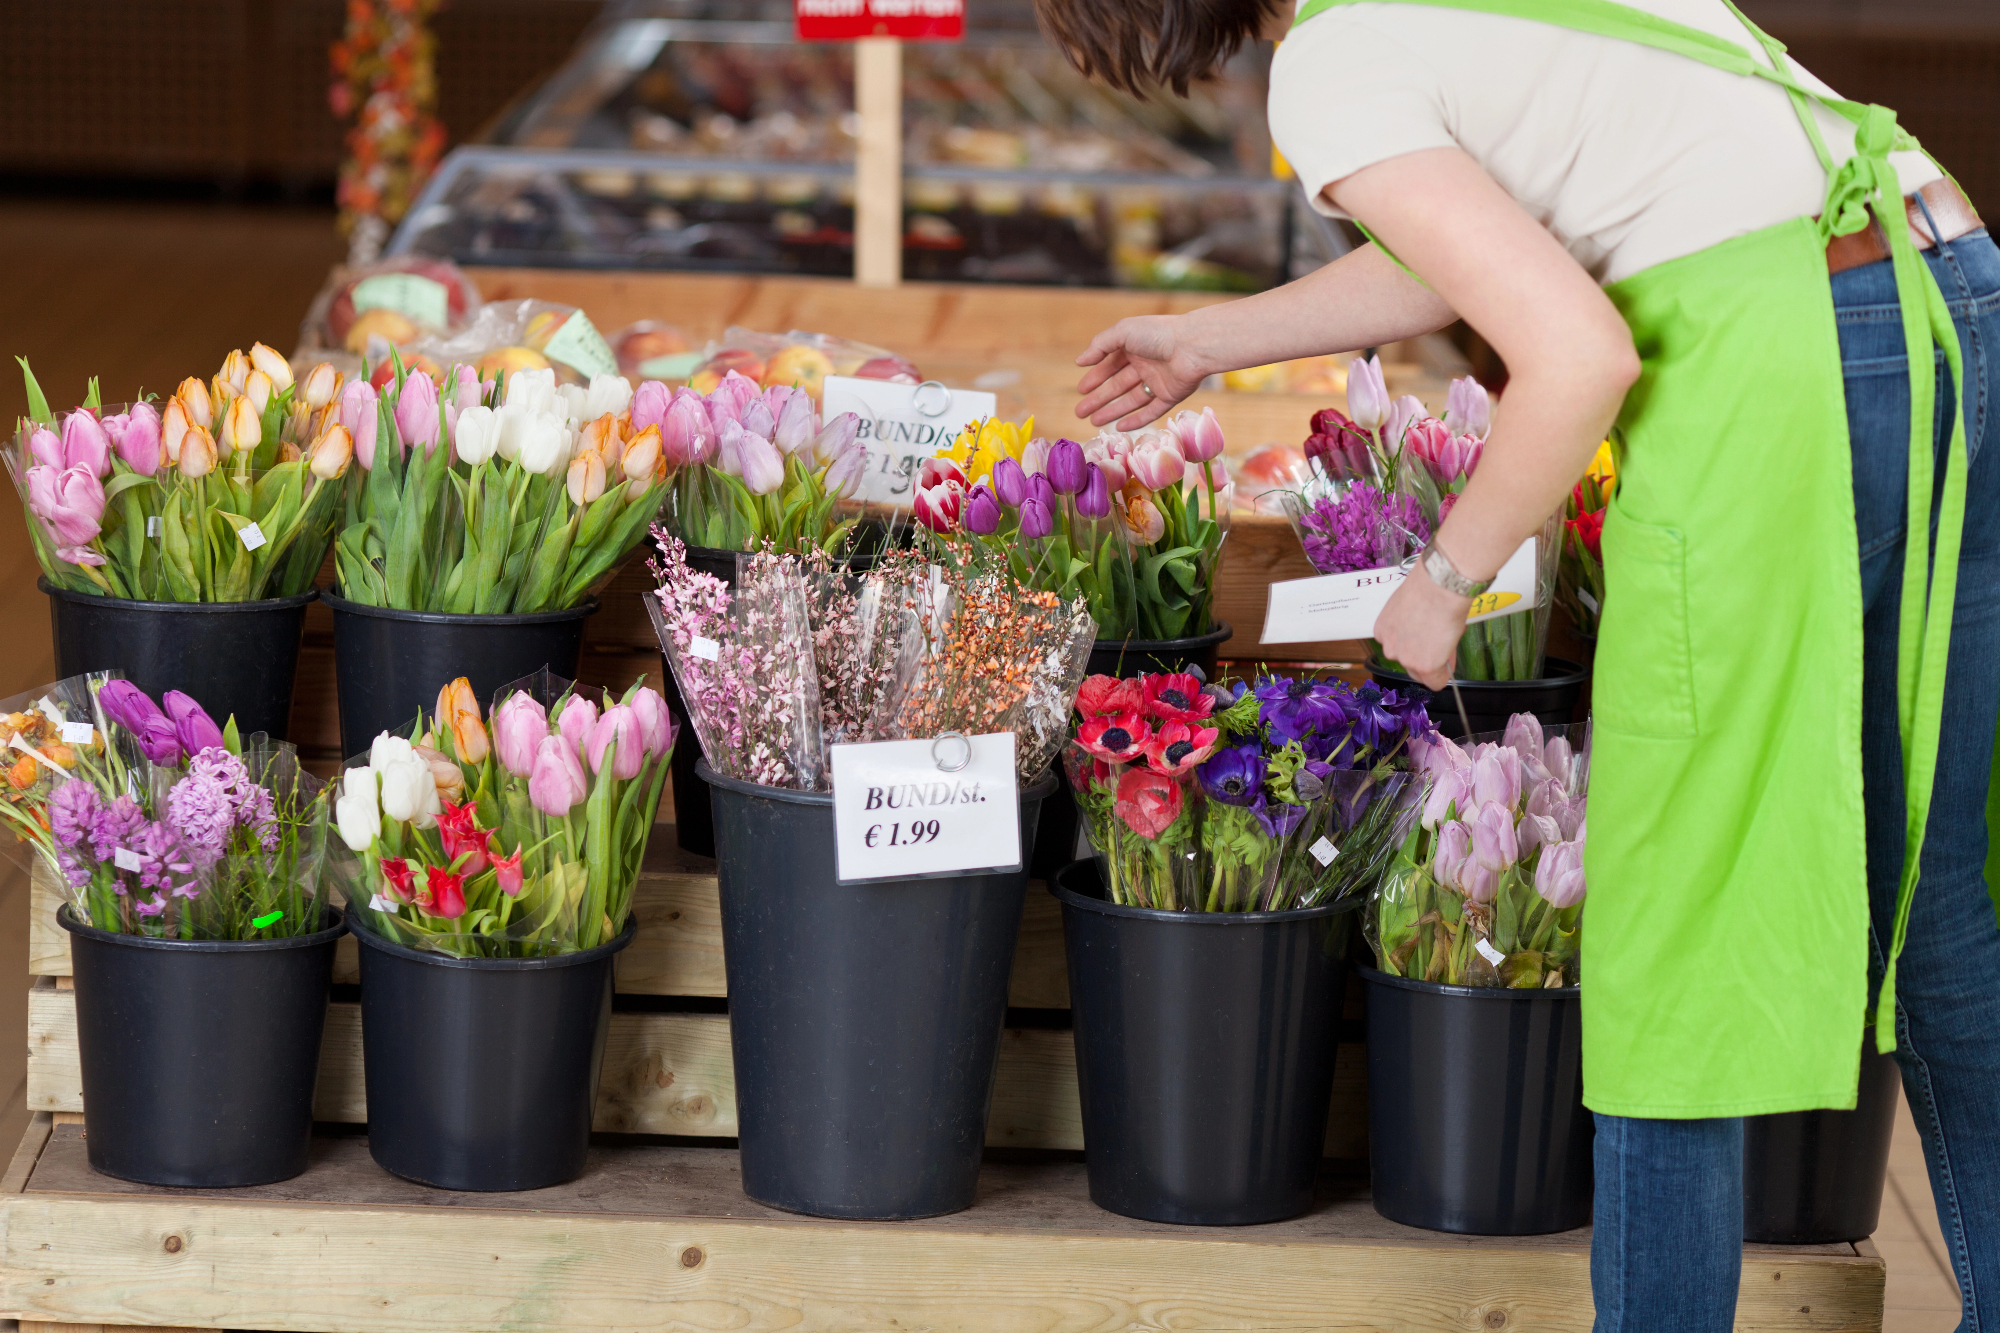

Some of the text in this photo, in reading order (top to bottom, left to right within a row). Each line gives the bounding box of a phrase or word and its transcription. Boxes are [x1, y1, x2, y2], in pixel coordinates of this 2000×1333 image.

[856, 418, 961, 447] BUND/s
[864, 780, 986, 811] BUND/st.
[864, 819, 940, 848] € 1.99
